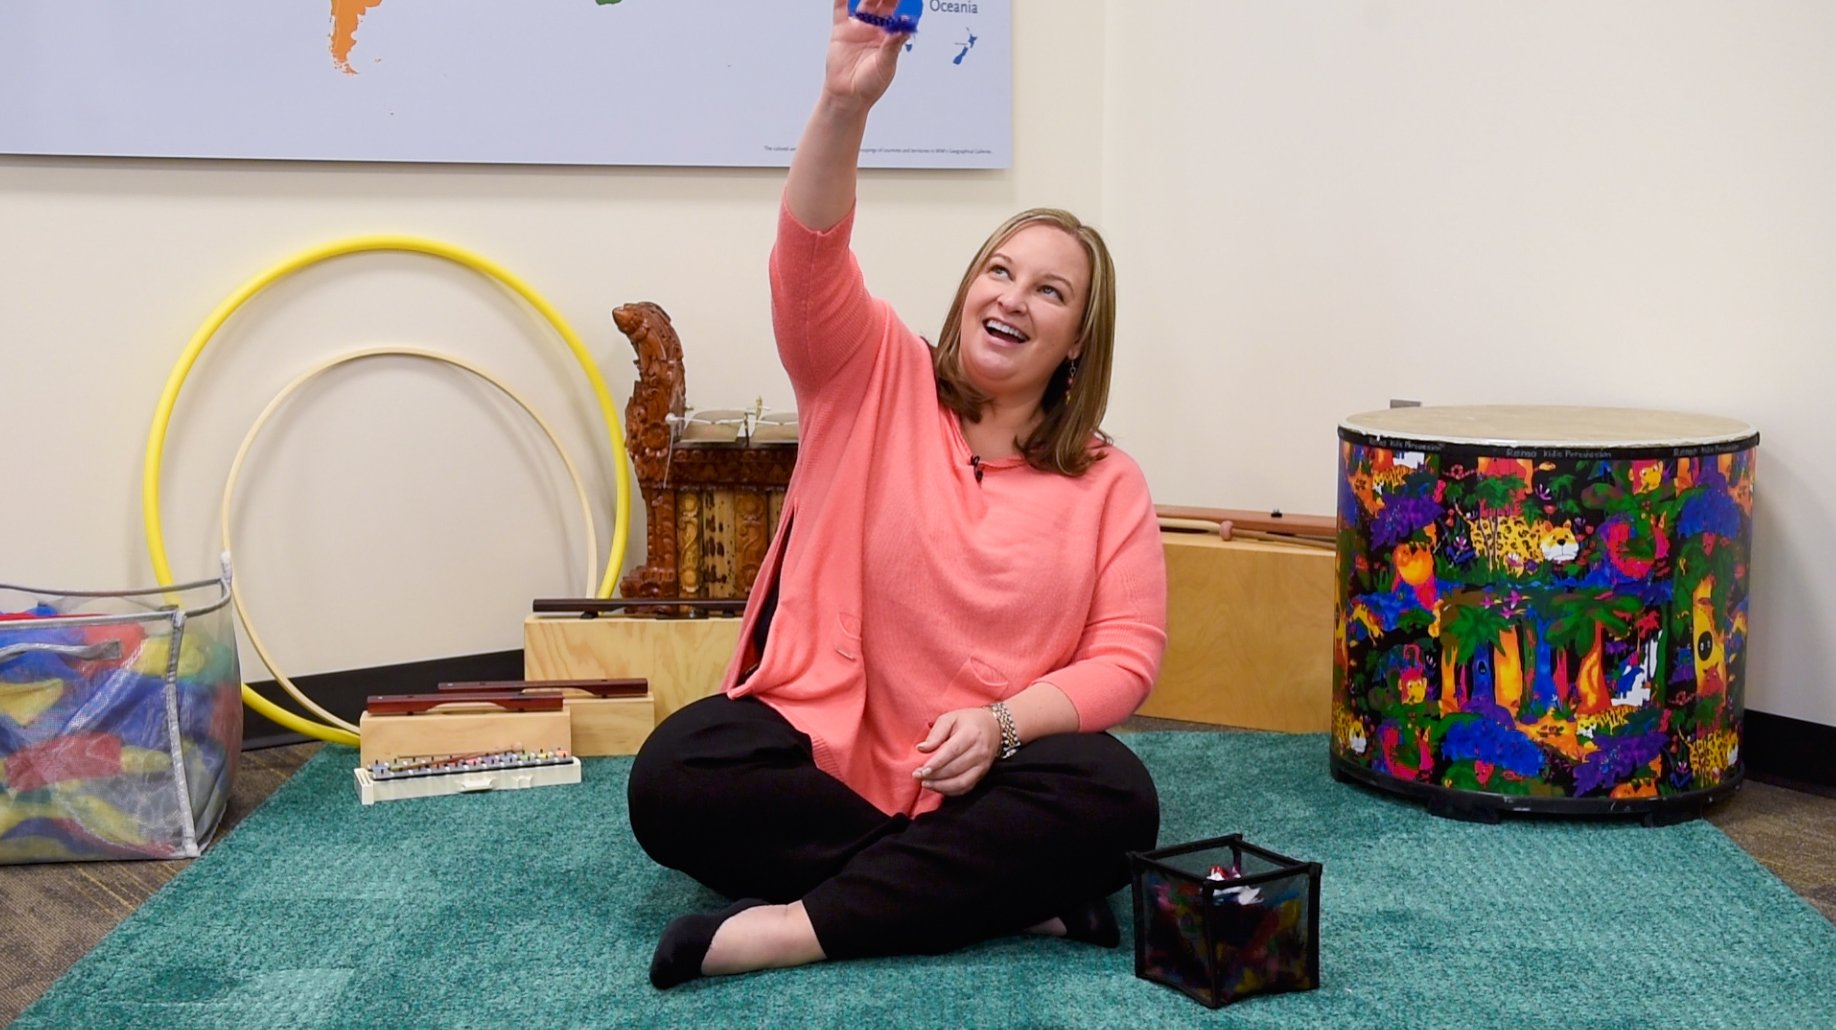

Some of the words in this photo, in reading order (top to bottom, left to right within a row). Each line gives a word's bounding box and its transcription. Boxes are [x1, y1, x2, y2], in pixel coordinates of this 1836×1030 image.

[929, 0, 978, 14] Oceania
[1506, 447, 1538, 458] Remo
[1565, 449, 1613, 459] Percussion
